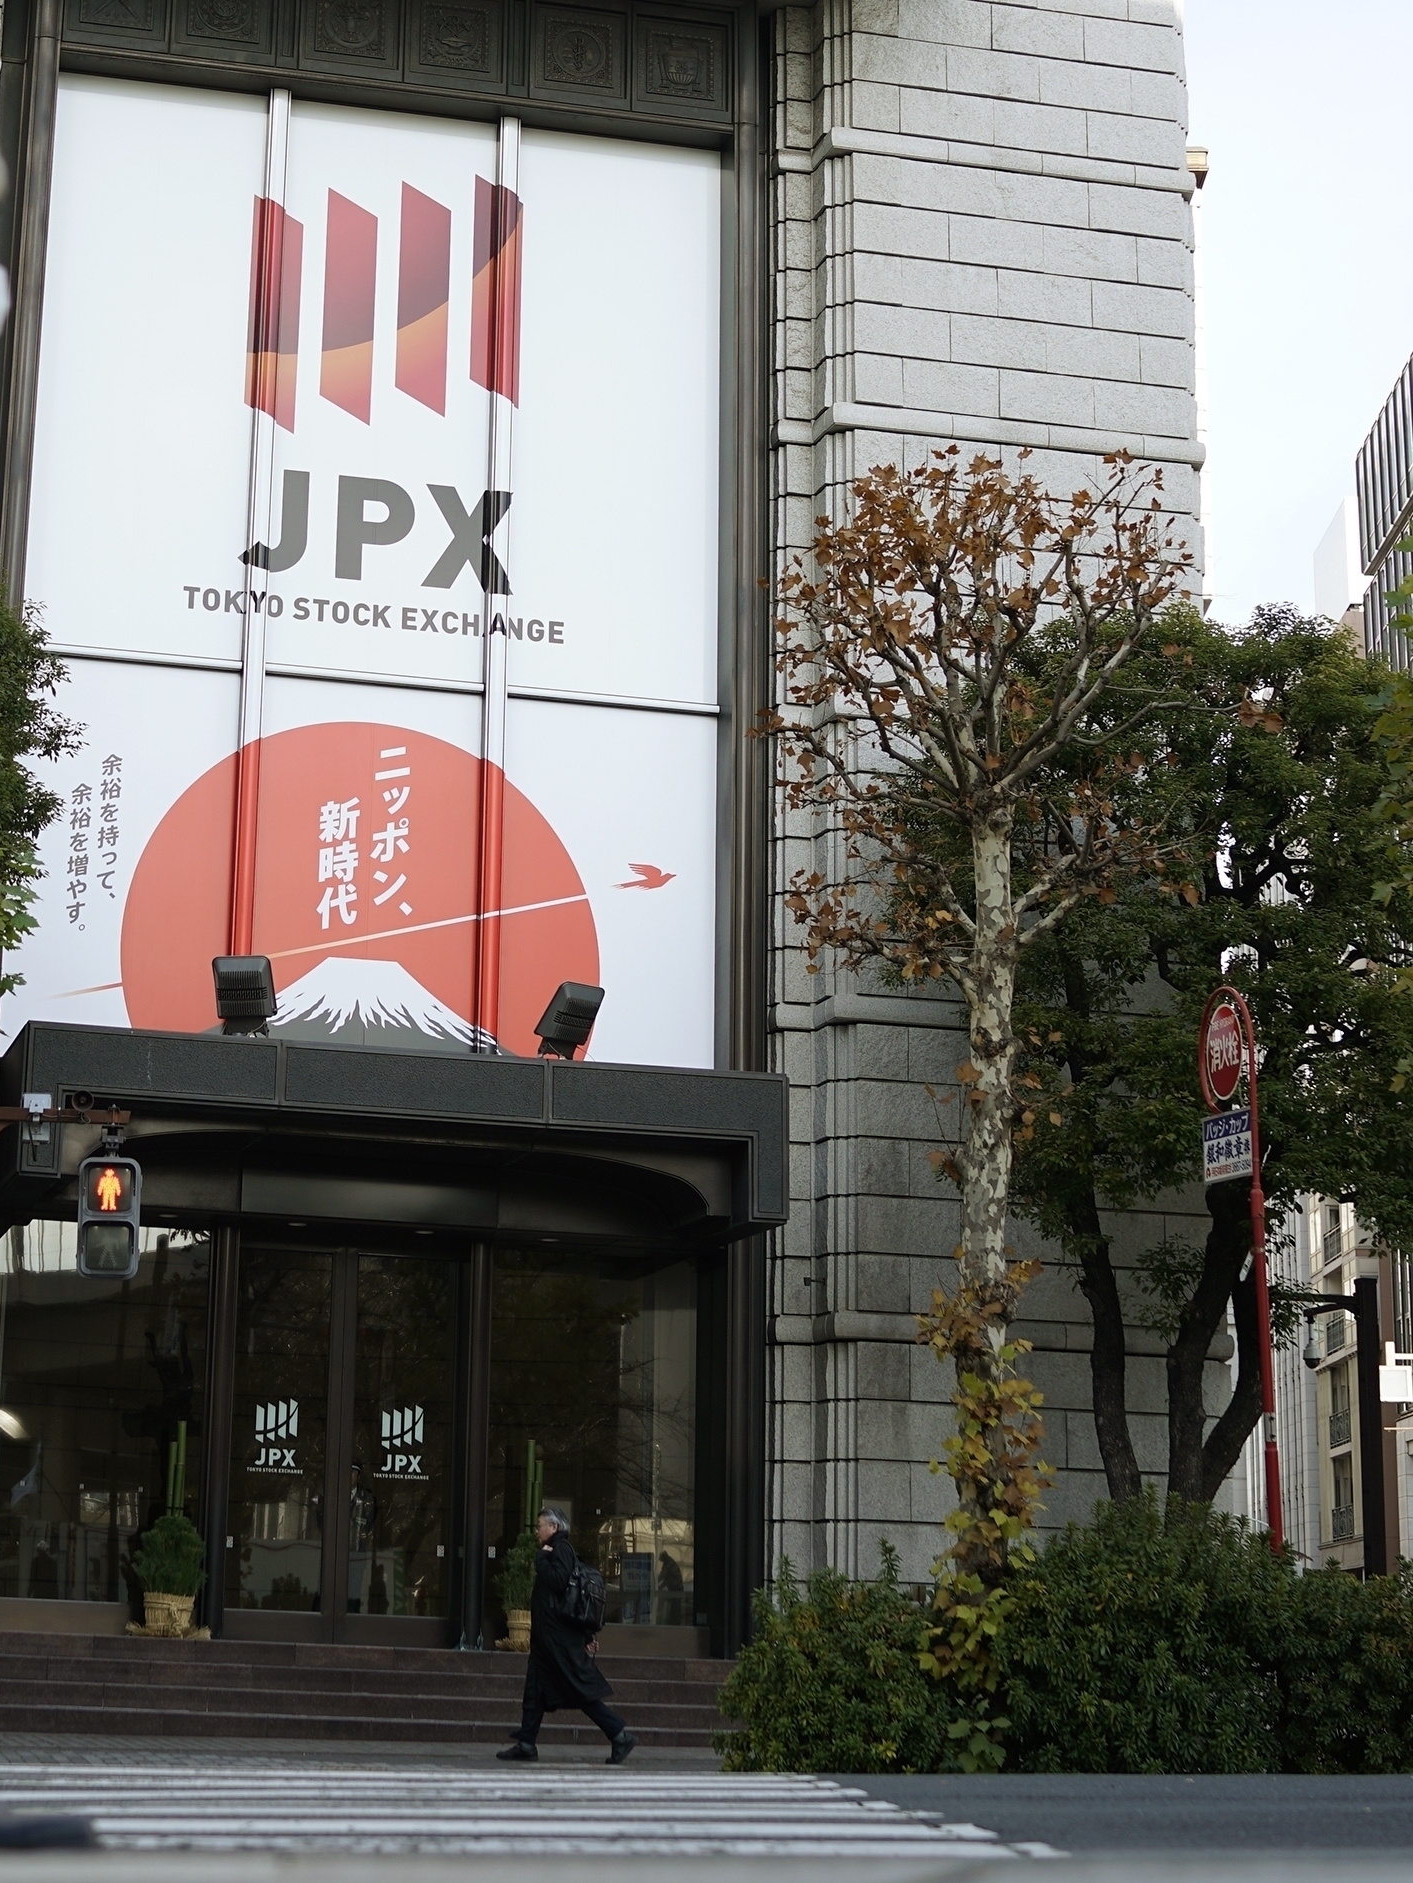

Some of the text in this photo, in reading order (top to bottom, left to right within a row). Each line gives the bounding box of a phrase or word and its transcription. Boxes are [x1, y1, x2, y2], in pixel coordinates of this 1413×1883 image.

[238, 469, 513, 595] JPX
[183, 585, 565, 644] TOKYO STOCK EXCHANGE
[66, 783, 93, 931] 余裕を増やす。
[97, 754, 123, 899] 余裕を持って、
[316, 797, 360, 930] 新時代
[370, 746, 413, 916] ニッポン、
[1209, 1030, 1239, 1073] 消火栓
[254, 1448, 296, 1467] JPX
[381, 1454, 422, 1473] JPX
